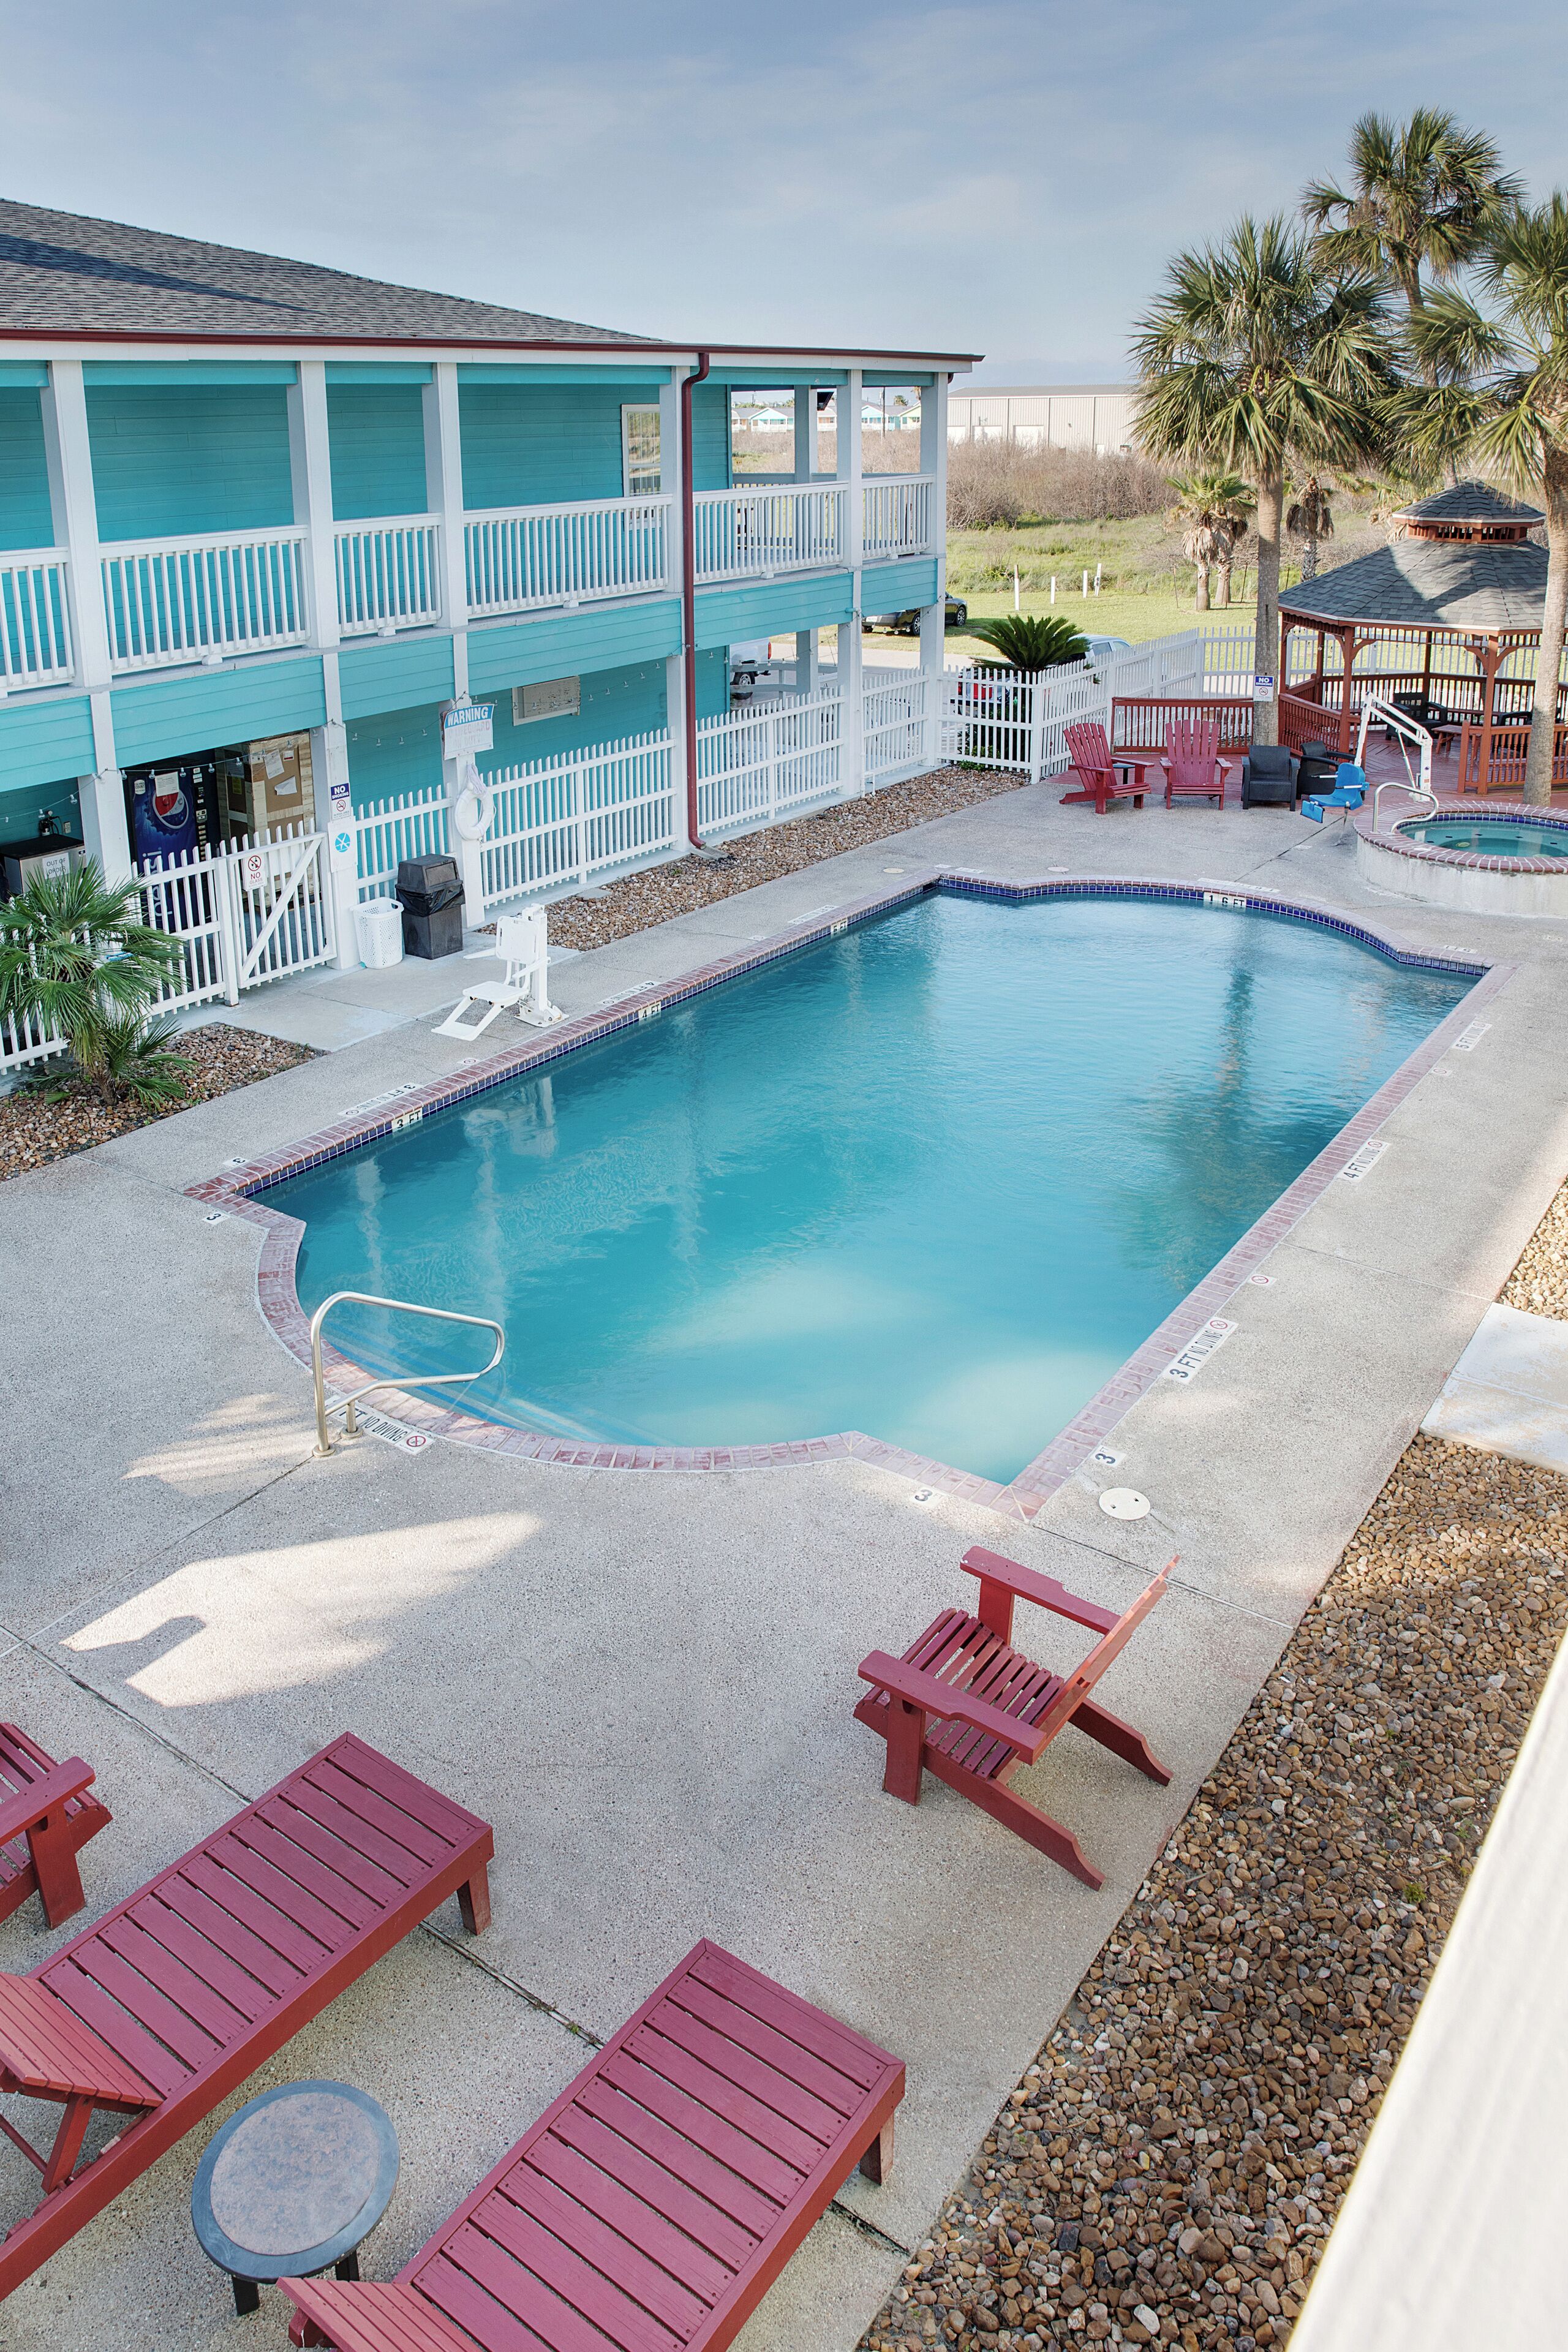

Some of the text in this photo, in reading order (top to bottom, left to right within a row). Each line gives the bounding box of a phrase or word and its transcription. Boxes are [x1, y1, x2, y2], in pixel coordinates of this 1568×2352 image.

[448, 707, 489, 727] WARNING
[334, 785, 346, 794] NO
[48, 865, 66, 874] ORDER
[397, 1110, 421, 1129] 3 FT
[1348, 1163, 1366, 1173] FT
[1169, 1330, 1223, 1378] 3 FT NO DIVING
[360, 1415, 380, 1429] NO
[372, 1422, 408, 1442] DIVING
[1095, 1453, 1115, 1464] 3
[914, 1489, 933, 1501] 3
